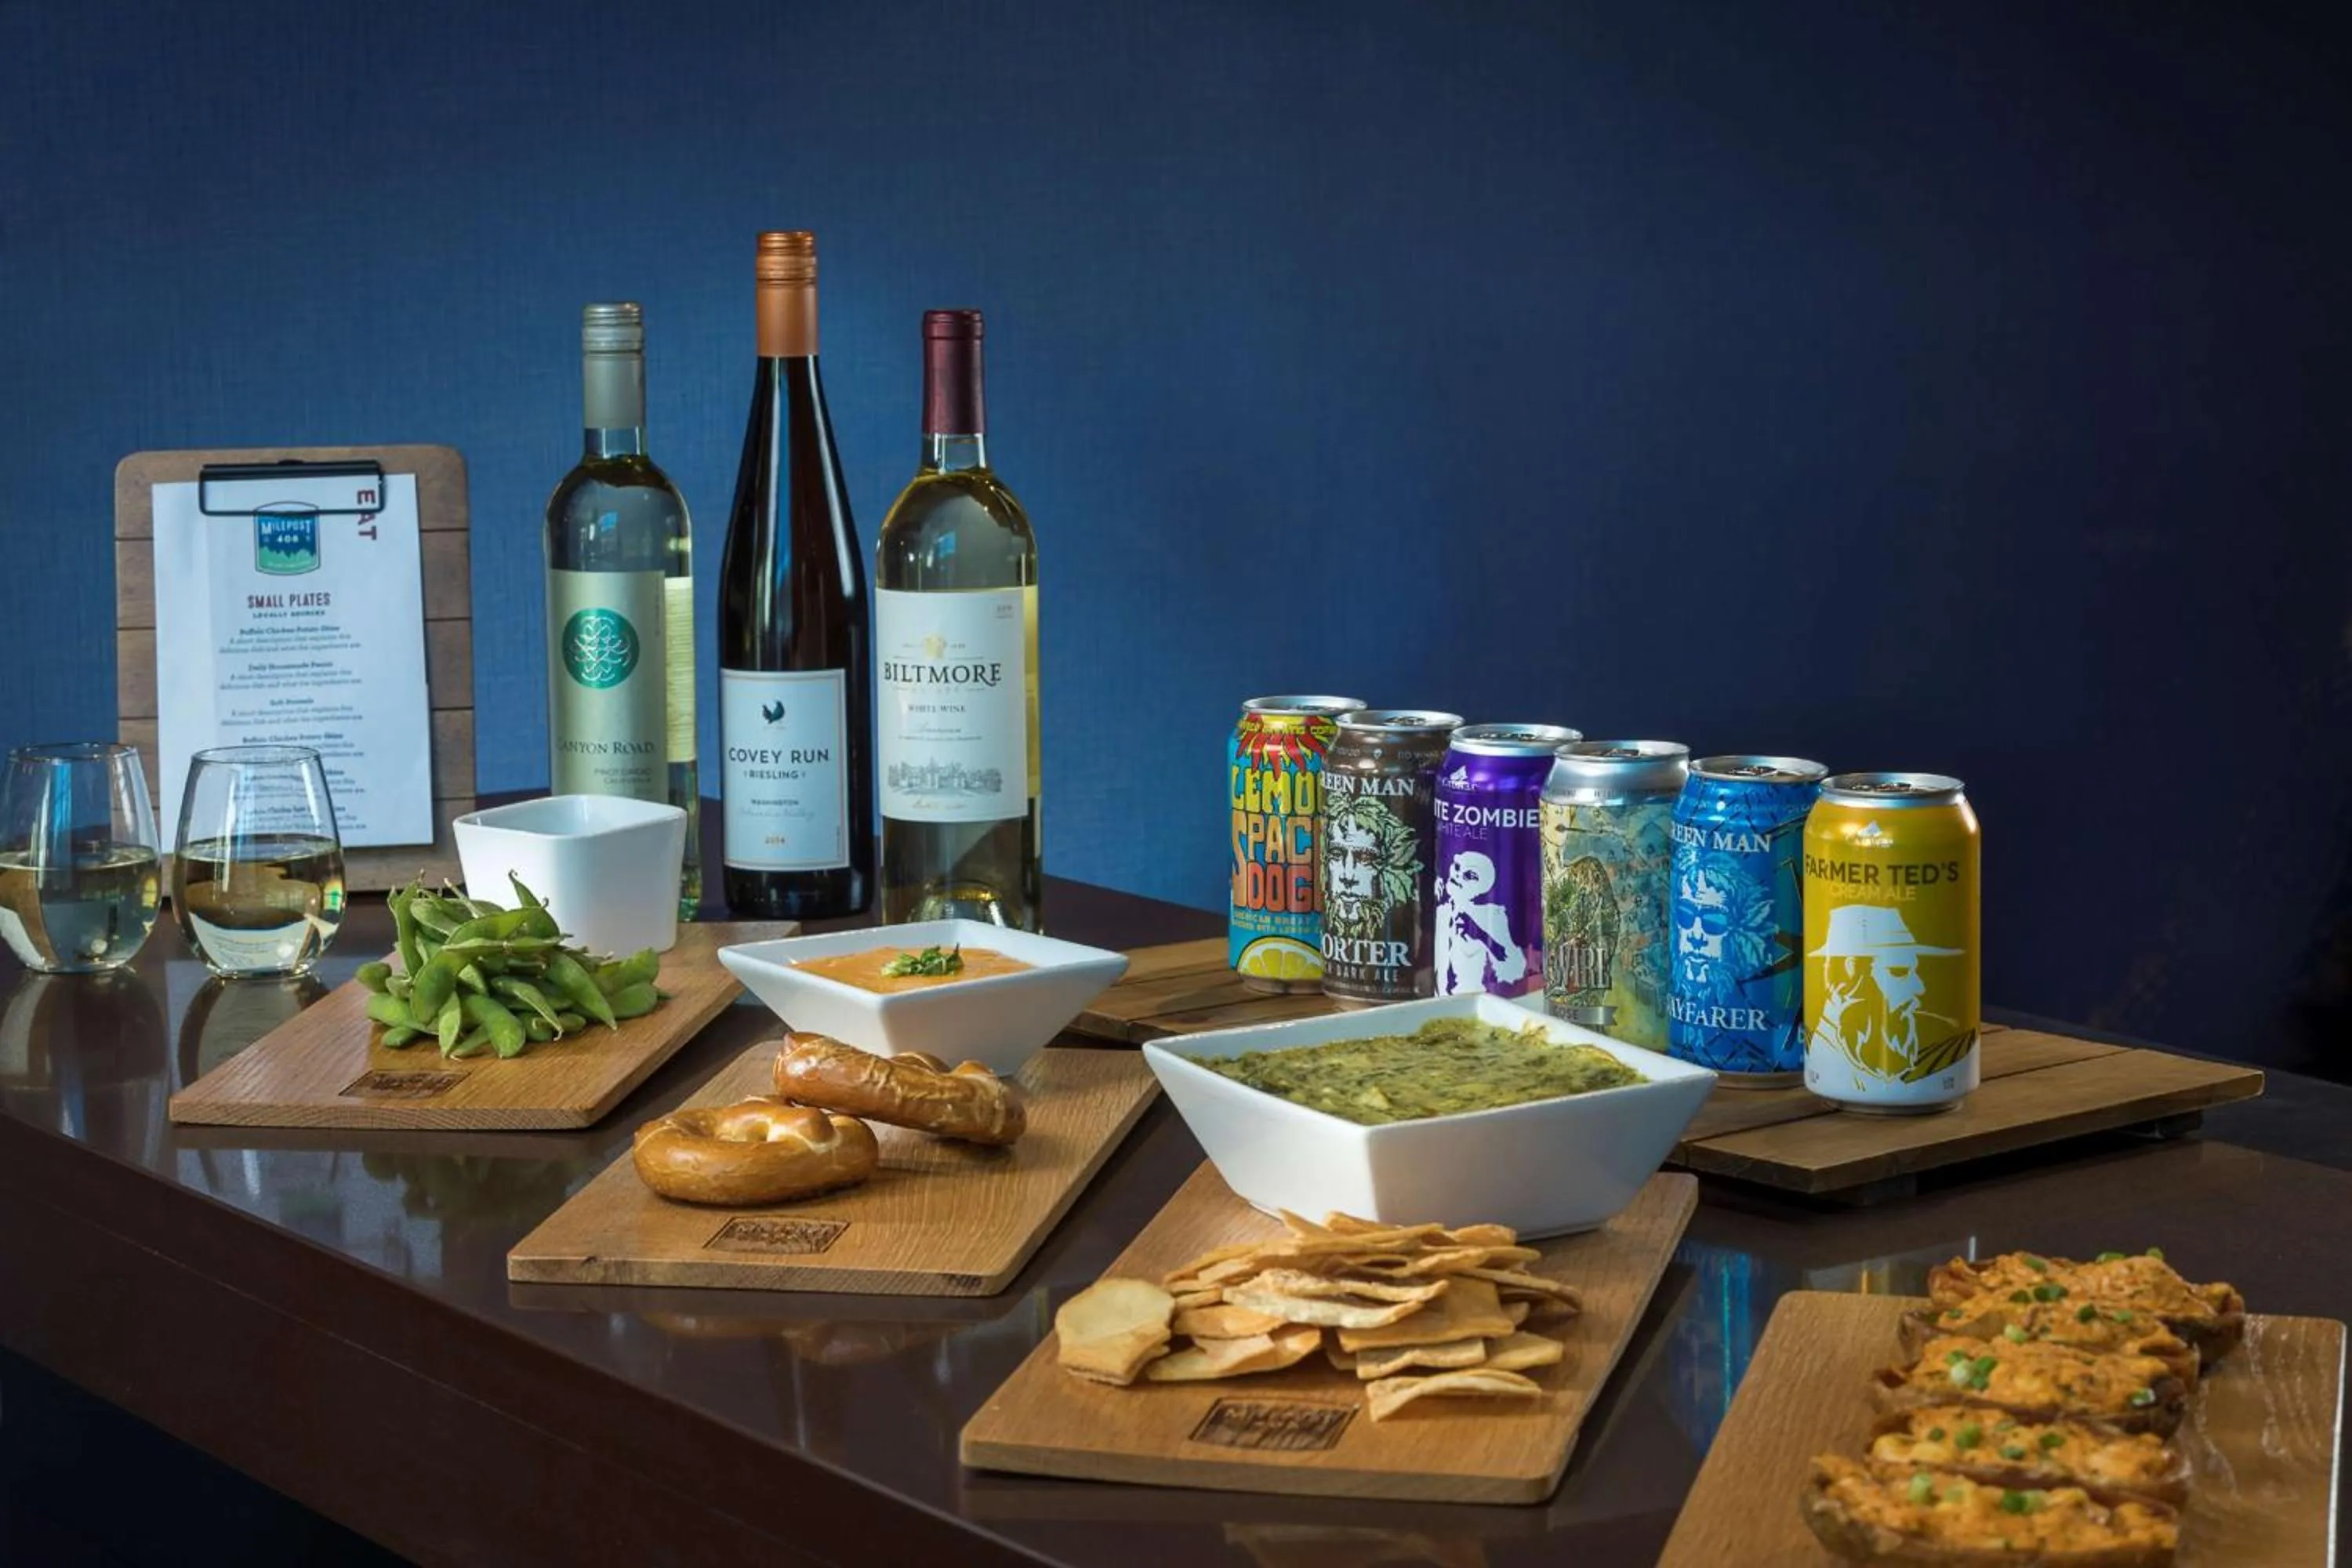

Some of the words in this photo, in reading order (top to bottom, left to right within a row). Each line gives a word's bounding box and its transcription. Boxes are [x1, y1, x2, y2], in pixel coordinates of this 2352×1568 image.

[247, 594, 284, 608] SMALL
[289, 592, 331, 607] PLATES
[884, 662, 1003, 688] BILTMORE
[940, 705, 966, 713] WINE
[613, 740, 655, 753] ROAD
[728, 746, 782, 764] COVEY
[791, 749, 829, 763] RUN
[749, 770, 799, 779] RIESLING
[1232, 765, 1324, 816] LEMO
[1360, 776, 1416, 797] MAN
[1434, 797, 1450, 822] ITE
[1453, 804, 1541, 828] ZOMBIE
[1462, 826, 1488, 841] ALE
[1712, 830, 1772, 853] MAN
[1806, 854, 1881, 886] FARMER
[1886, 860, 1959, 886] TED'S
[1247, 862, 1313, 913] DOG
[1829, 882, 1883, 902] CREAM
[1885, 885, 1917, 902] ALE
[1320, 932, 1413, 967] ORTER
[1374, 969, 1399, 982] ALE
[1682, 1024, 1705, 1047] IPA
